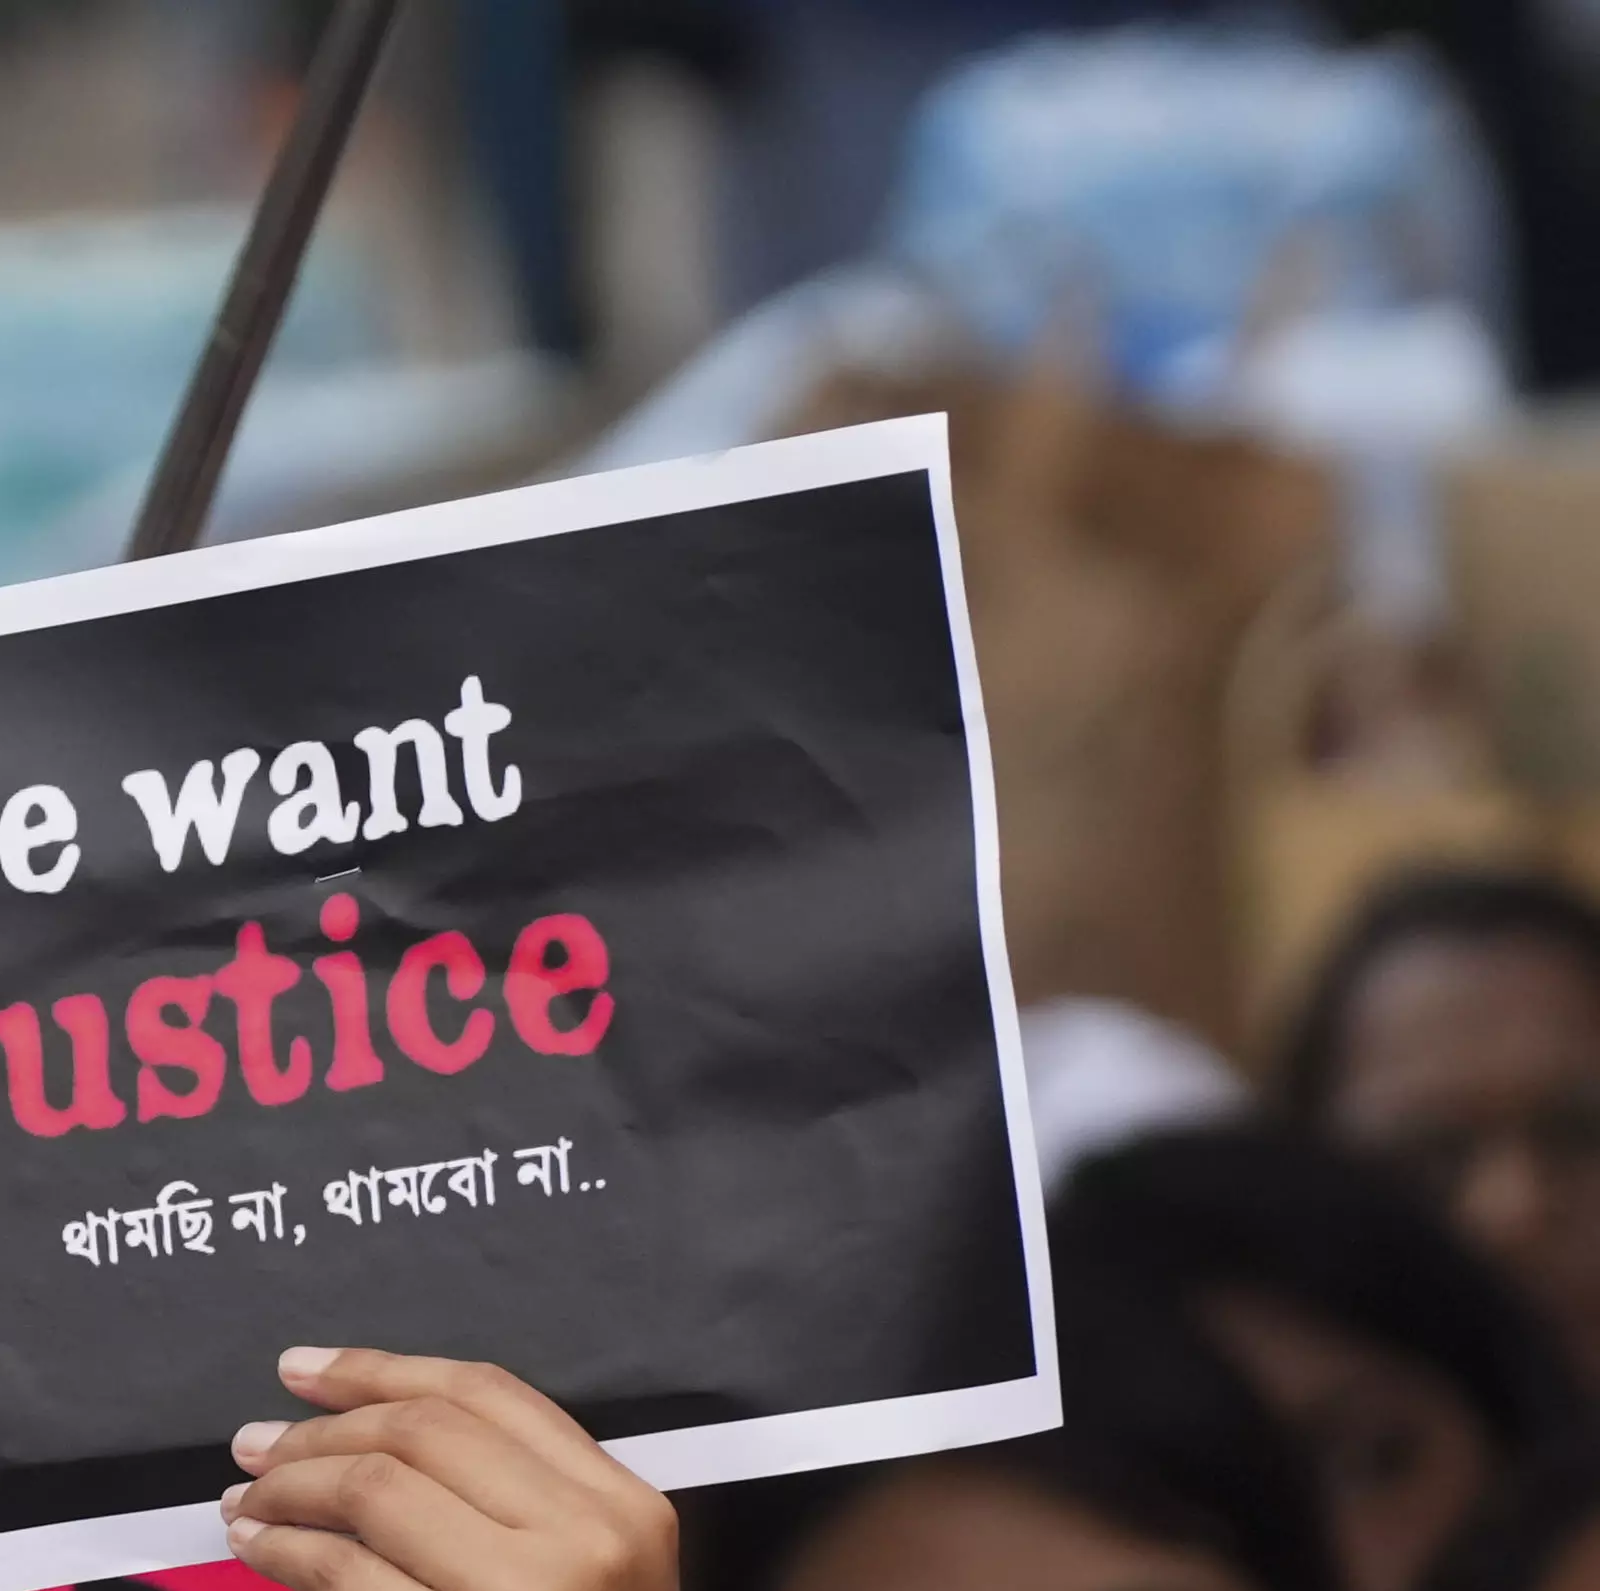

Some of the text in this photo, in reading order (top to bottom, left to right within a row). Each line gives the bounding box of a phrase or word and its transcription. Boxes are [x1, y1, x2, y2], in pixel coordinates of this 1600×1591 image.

[121, 675, 522, 873] want
[62, 1136, 607, 1267] থামছি না, থামবো না..
